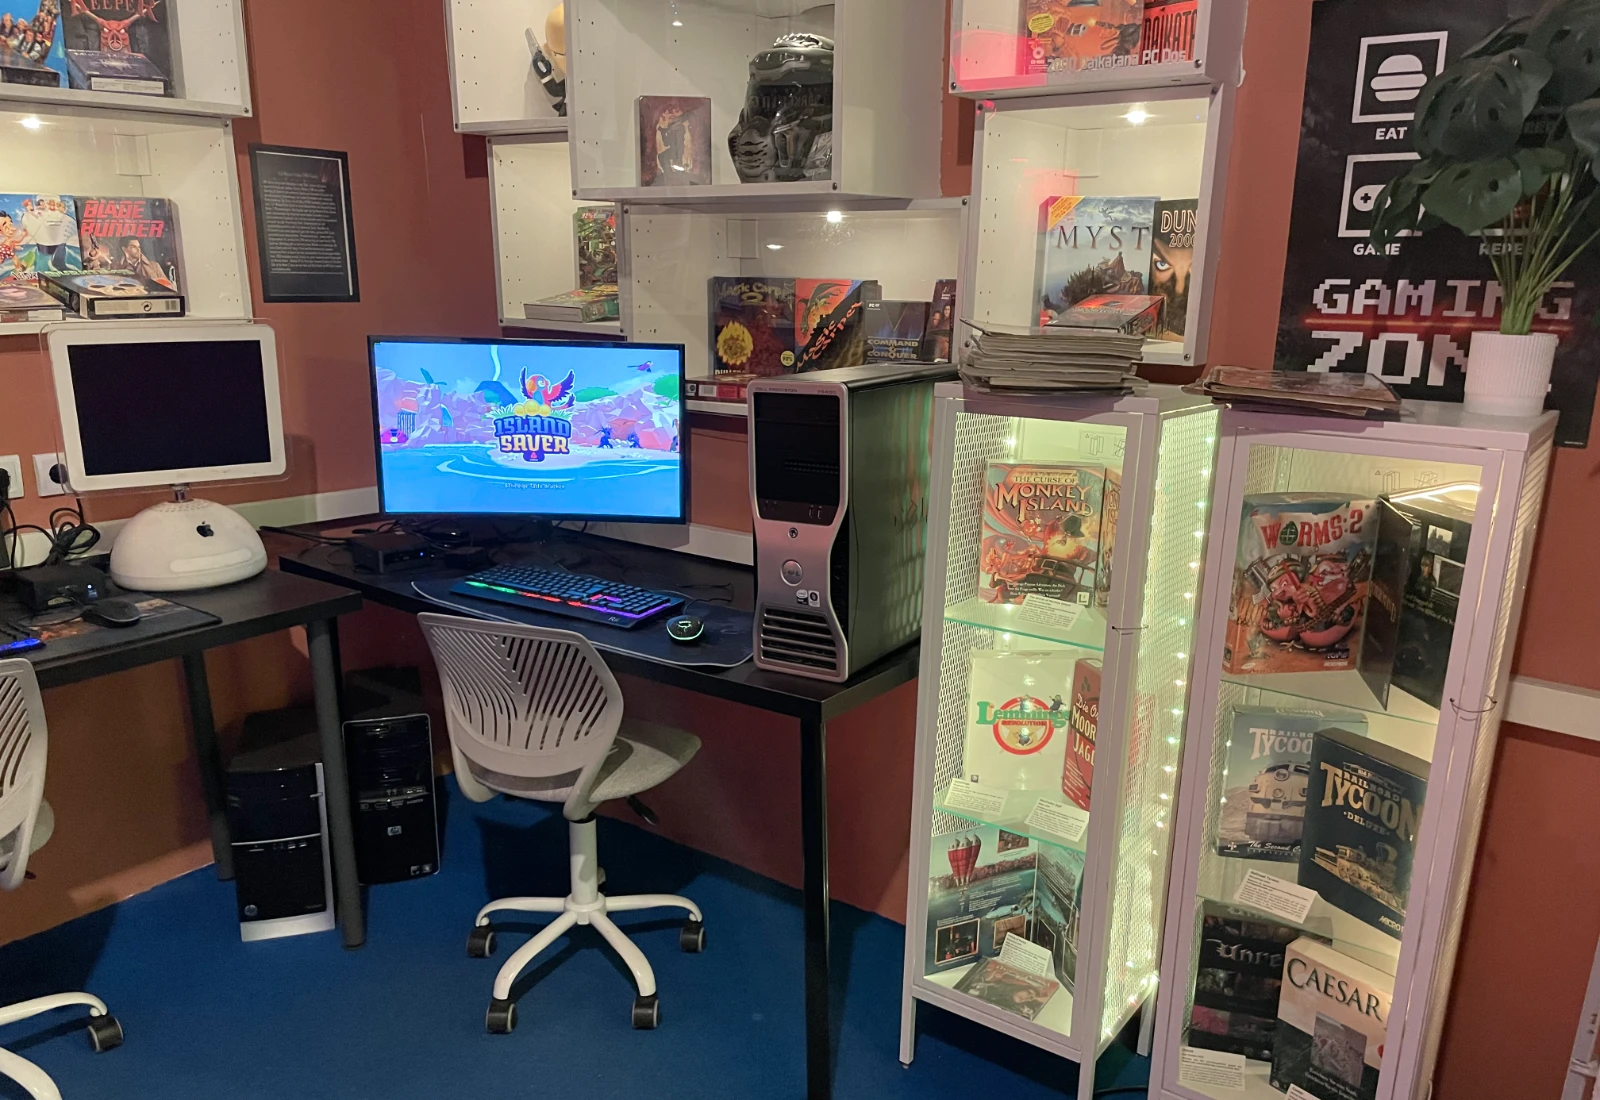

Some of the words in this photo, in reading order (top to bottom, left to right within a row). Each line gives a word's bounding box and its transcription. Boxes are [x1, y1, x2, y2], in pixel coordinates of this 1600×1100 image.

[1142, 51, 1159, 65] PC
[1162, 49, 1186, 63] Dos
[1375, 127, 1408, 140] EAT
[83, 200, 146, 219] BLADE
[80, 219, 165, 238] RUNNER
[1057, 225, 1150, 250] MYST
[867, 339, 919, 347] COMMAND
[867, 351, 918, 360] CONQUER
[495, 416, 570, 437] ISLAND
[500, 434, 569, 453] SAVER
[996, 483, 1091, 512] MONKEY
[1017, 499, 1093, 522] ISLAND
[976, 701, 1072, 728] Lemmings
[1071, 705, 1097, 741] MOOR
[1344, 771, 1400, 802] RAILROAD
[1320, 761, 1425, 842] TYCOON
[1286, 957, 1383, 1022] CAESAR
